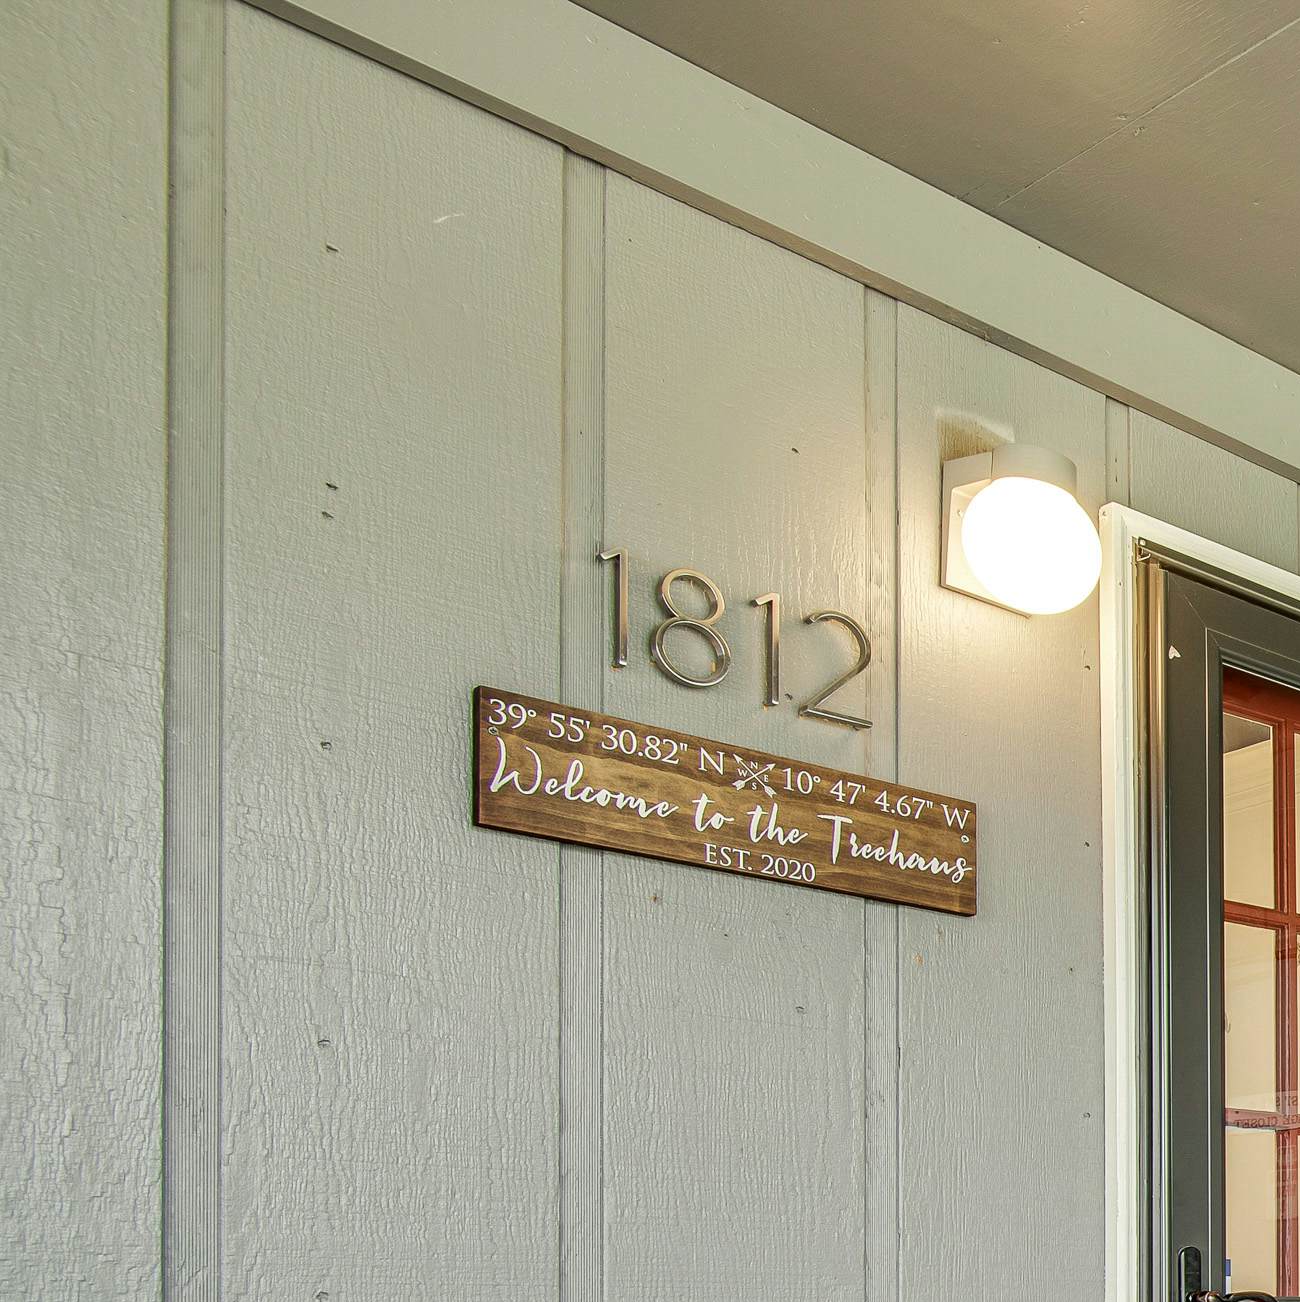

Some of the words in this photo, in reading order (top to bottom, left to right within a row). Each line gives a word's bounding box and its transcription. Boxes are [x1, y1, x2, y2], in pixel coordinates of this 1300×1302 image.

[598, 548, 873, 729] 1812
[488, 698, 537, 729] 39°
[548, 712, 591, 743] 55'
[601, 724, 688, 765] 30.82"
[698, 747, 725, 776] N
[782, 767, 821, 794] 10°
[829, 779, 866, 805] 47'
[874, 790, 933, 820] 4.67"
[940, 803, 971, 830] W
[738, 769, 748, 777] W
[750, 761, 758, 769] N
[751, 782, 757, 790] S
[763, 774, 769, 782] E
[489, 736, 679, 818] Welcome
[692, 793, 735, 832] to
[746, 802, 809, 846] the
[816, 814, 973, 884] Treehaus
[704, 842, 753, 871] EST.
[761, 854, 816, 883] 2020
